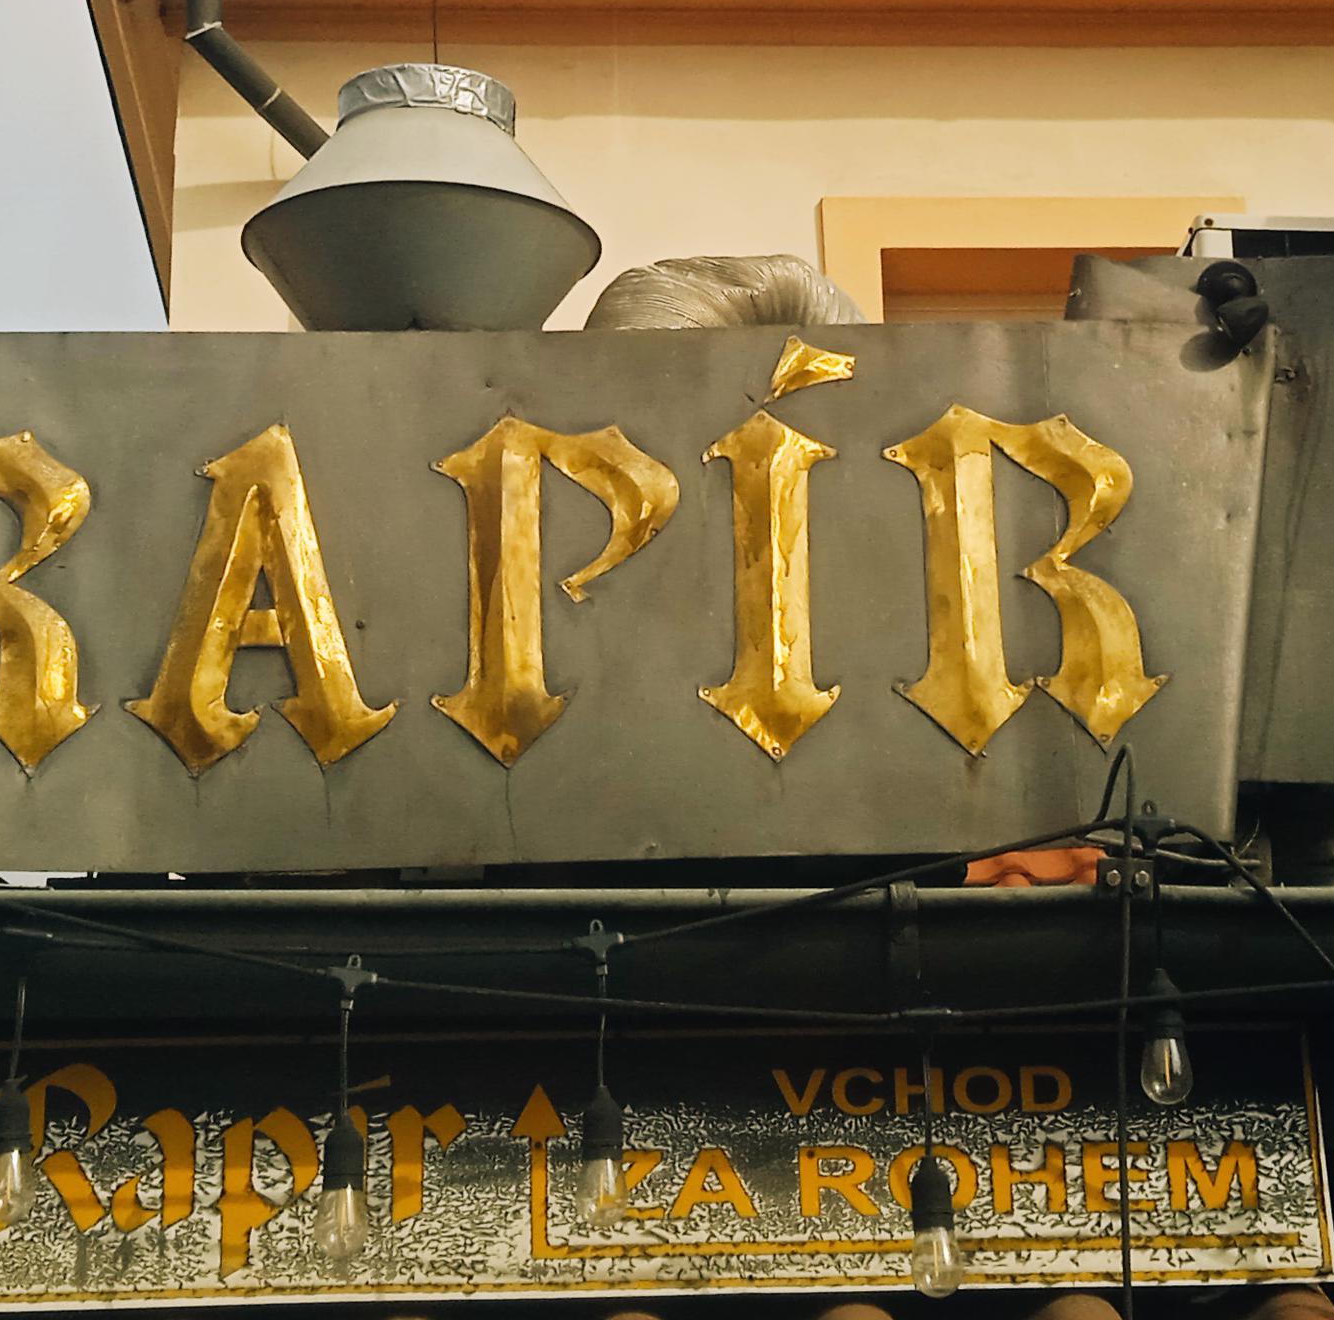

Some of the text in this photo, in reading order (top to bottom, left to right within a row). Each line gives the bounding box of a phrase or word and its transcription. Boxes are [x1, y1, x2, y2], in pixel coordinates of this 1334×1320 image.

[772, 1066, 1073, 1117] VCHOD
[595, 1140, 1259, 1220] ZA ROHEM
